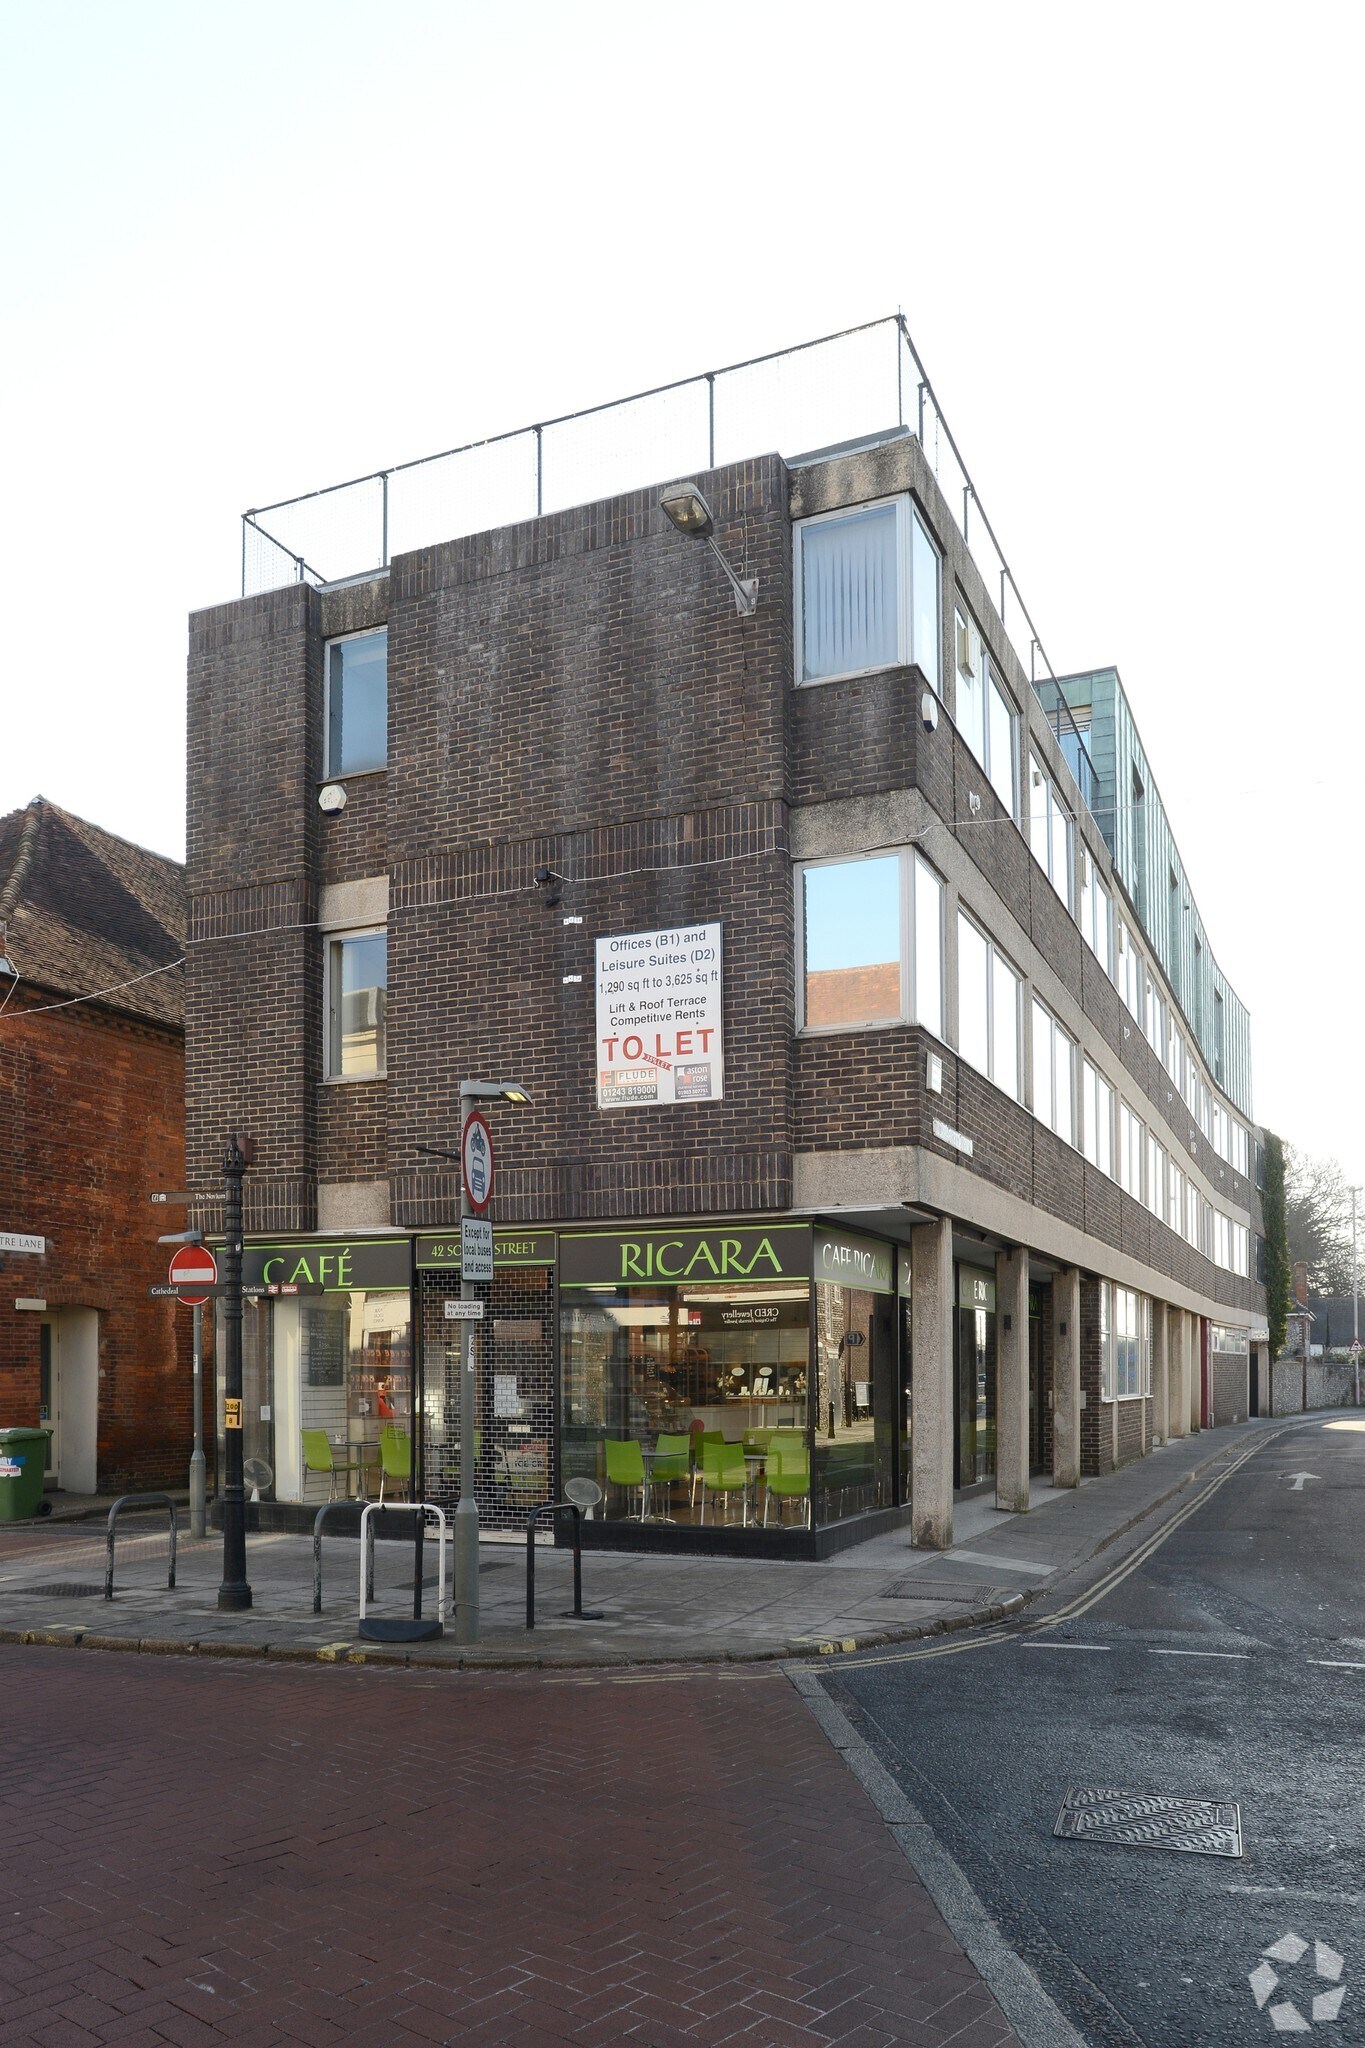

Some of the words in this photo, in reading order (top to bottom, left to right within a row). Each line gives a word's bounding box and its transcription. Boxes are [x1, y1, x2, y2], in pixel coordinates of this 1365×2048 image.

[610, 939, 652, 952] Offices
[655, 933, 680, 949] (B1)
[683, 930, 706, 943] and
[601, 959, 646, 972] Leisure
[649, 953, 687, 967] Suites
[690, 947, 715, 964] (D2)
[599, 980, 625, 995] 1,290
[627, 981, 640, 992] sq
[642, 978, 650, 989] ft
[652, 977, 663, 988] to
[665, 973, 692, 988] 3,625
[695, 973, 708, 984] sq
[711, 970, 718, 981] ft
[609, 1003, 626, 1014] Lift
[628, 1002, 636, 1012] &
[640, 999, 664, 1010] Roof
[667, 996, 707, 1007] Terrace
[610, 1013, 672, 1026] Competitive
[675, 1009, 706, 1020] Rents
[602, 1035, 643, 1061] TO
[656, 1028, 715, 1058] LET
[618, 1070, 654, 1080] FLUDE
[686, 1066, 708, 1075] aston
[692, 1075, 708, 1083] rose
[602, 1087, 626, 1097] 01243
[627, 1085, 656, 1095] 819000
[605, 1094, 654, 1102] www.flude.com
[205, 1192, 226, 1200] Novium
[464, 1225, 482, 1240] Except
[482, 1227, 490, 1240] for
[20, 1238, 42, 1249] LANE
[431, 1245, 444, 1257] 42
[494, 1241, 537, 1255] STREET
[463, 1242, 477, 1256] local
[477, 1243, 491, 1257] buses
[619, 1237, 783, 1278] RICARA
[262, 1247, 353, 1287] CAFÉ
[464, 1261, 474, 1273] and
[475, 1264, 492, 1273] access
[151, 1286, 179, 1295] Cathedral
[241, 1286, 265, 1294] Stations
[458, 1303, 480, 1311] loading
